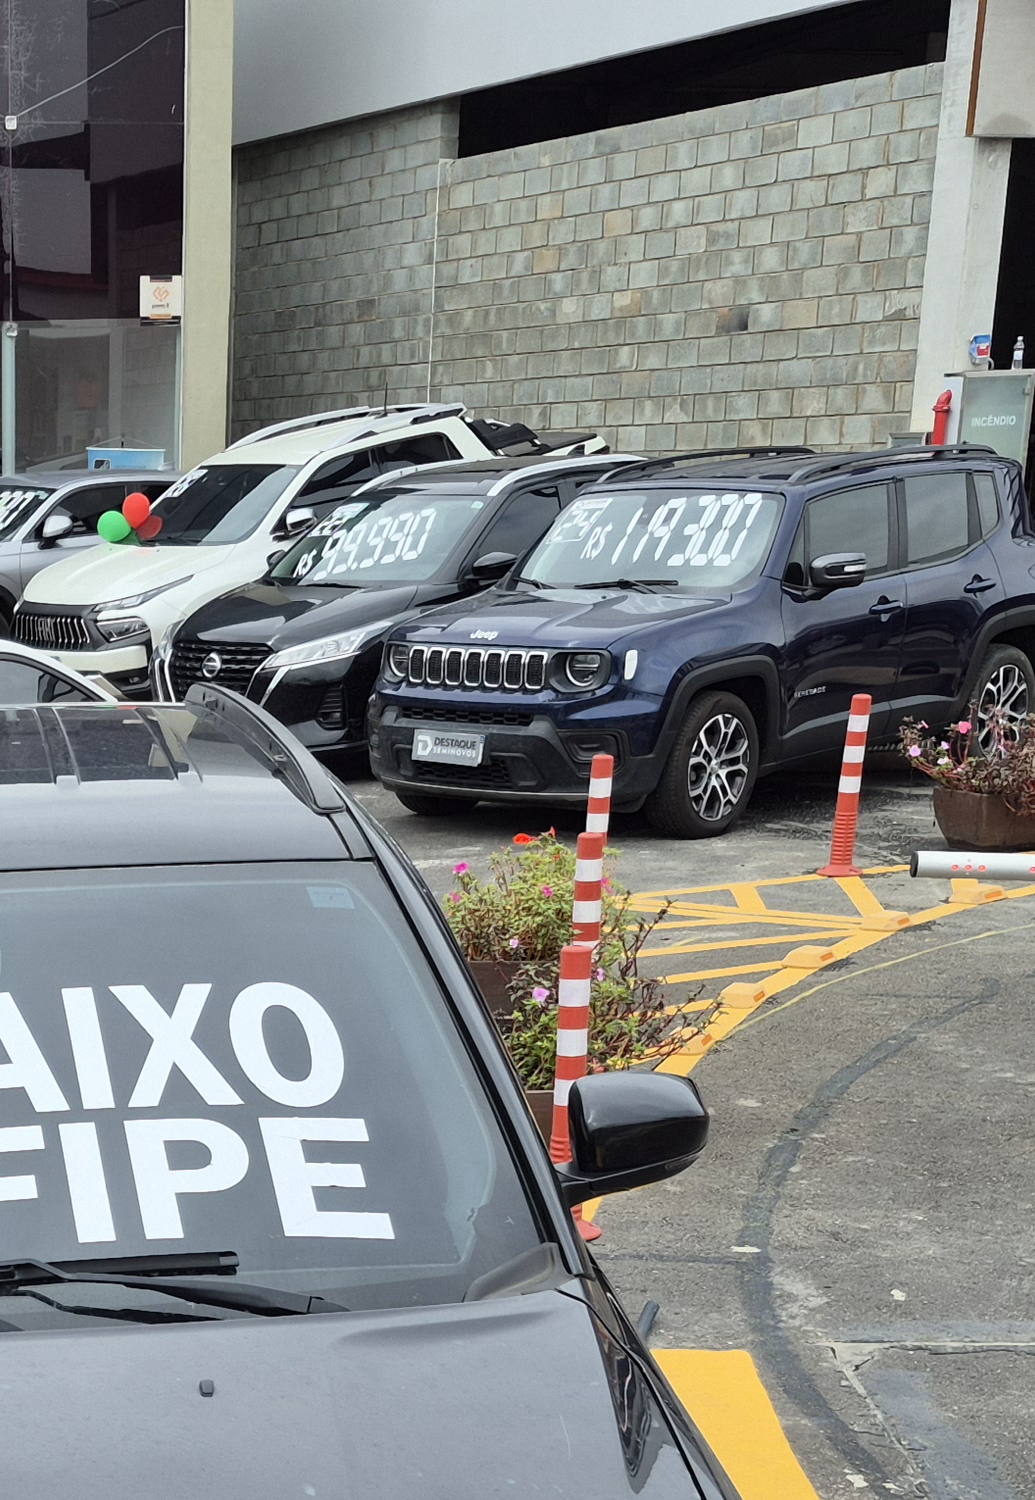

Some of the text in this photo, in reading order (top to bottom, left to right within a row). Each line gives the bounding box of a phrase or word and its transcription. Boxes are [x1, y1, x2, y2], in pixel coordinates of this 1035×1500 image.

[971, 414, 1017, 428] INCÊNDIO
[580, 522, 612, 560] R$
[293, 549, 317, 578] R$
[470, 629, 499, 641] Jeep
[434, 736, 477, 750] DESTAQUE
[433, 746, 477, 758] SEMINOVOS
